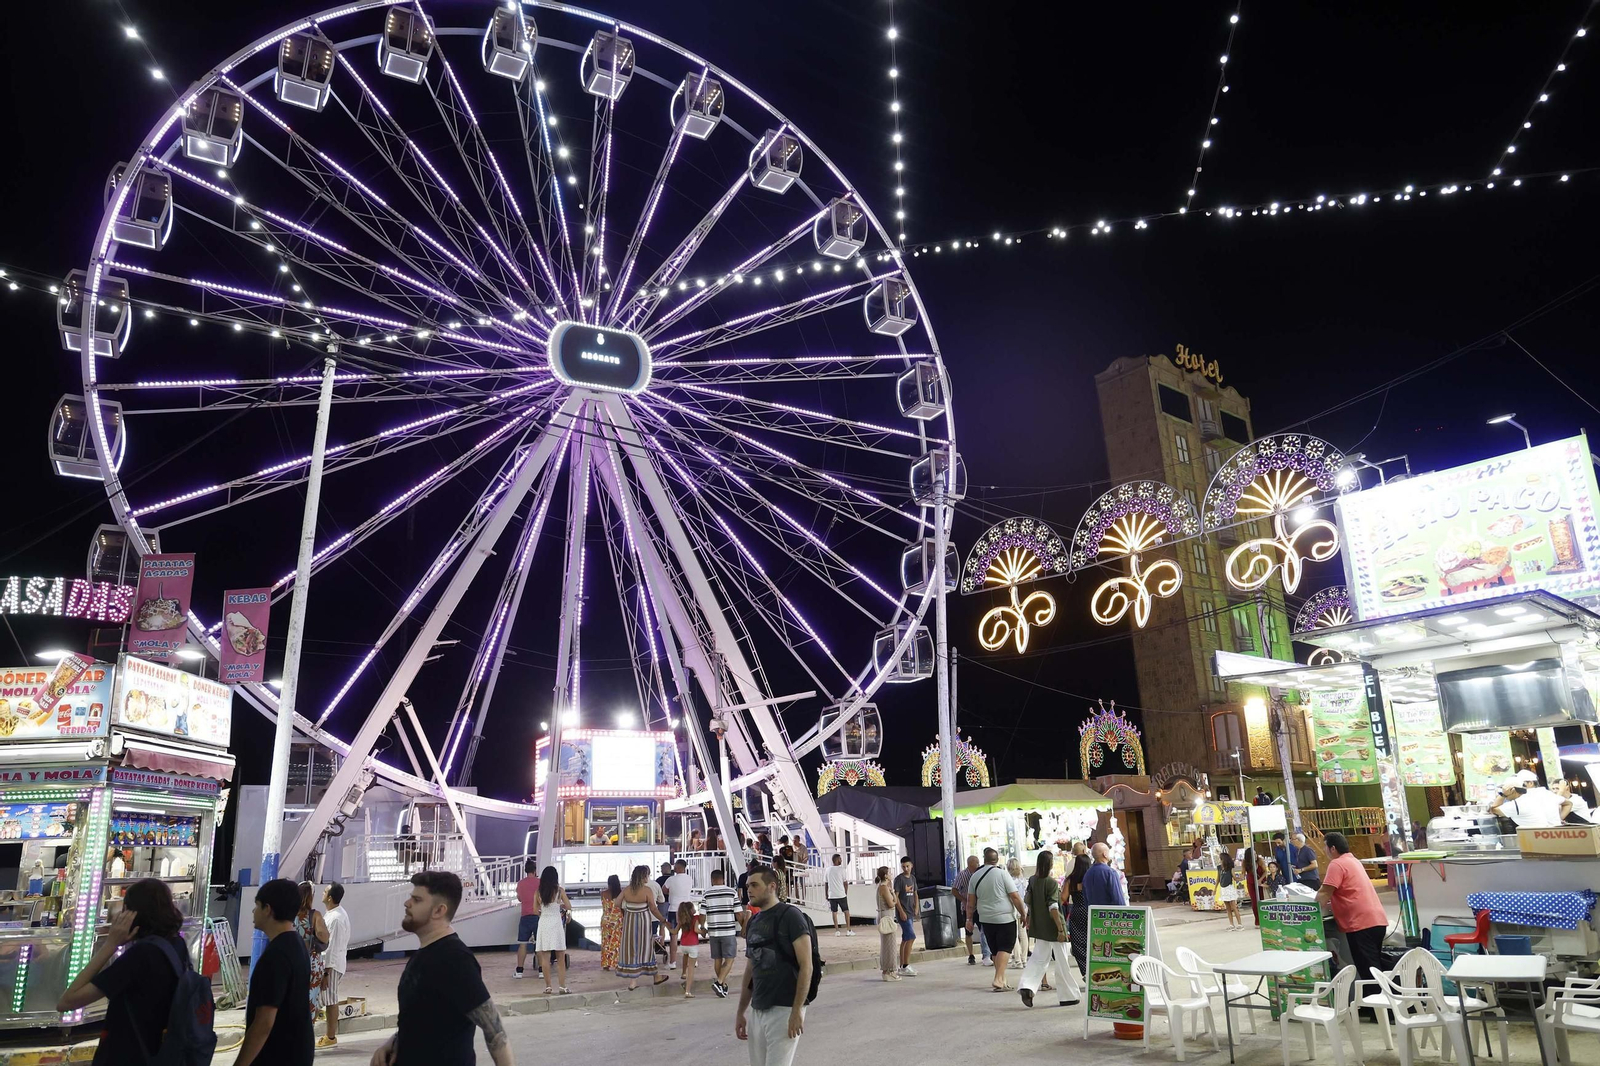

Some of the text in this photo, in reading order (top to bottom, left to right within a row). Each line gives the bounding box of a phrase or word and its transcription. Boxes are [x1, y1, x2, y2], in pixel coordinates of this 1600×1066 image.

[1175, 343, 1224, 383] Hotel
[1469, 484, 1560, 514] PACO
[143, 560, 193, 569] PATATAS
[144, 569, 188, 578] ASADAS
[0, 575, 135, 622] ASADAS
[227, 593, 267, 604] KEBAB
[127, 659, 177, 684] PATATAS ASADAS
[0, 671, 47, 685] ÖNER
[60, 726, 98, 734] BEBIDAS
[29, 771, 42, 781] Y
[114, 771, 145, 783] PATATAS
[146, 774, 171, 785] ASADAS
[196, 782, 218, 792] KEBAB
[1534, 830, 1588, 839] POLVILLO
[1189, 876, 1216, 886] Buñuelos
[1099, 911, 1106, 919] El
[1122, 911, 1140, 920] Paco
[1269, 912, 1277, 921] El
[1293, 913, 1311, 921] Paco
